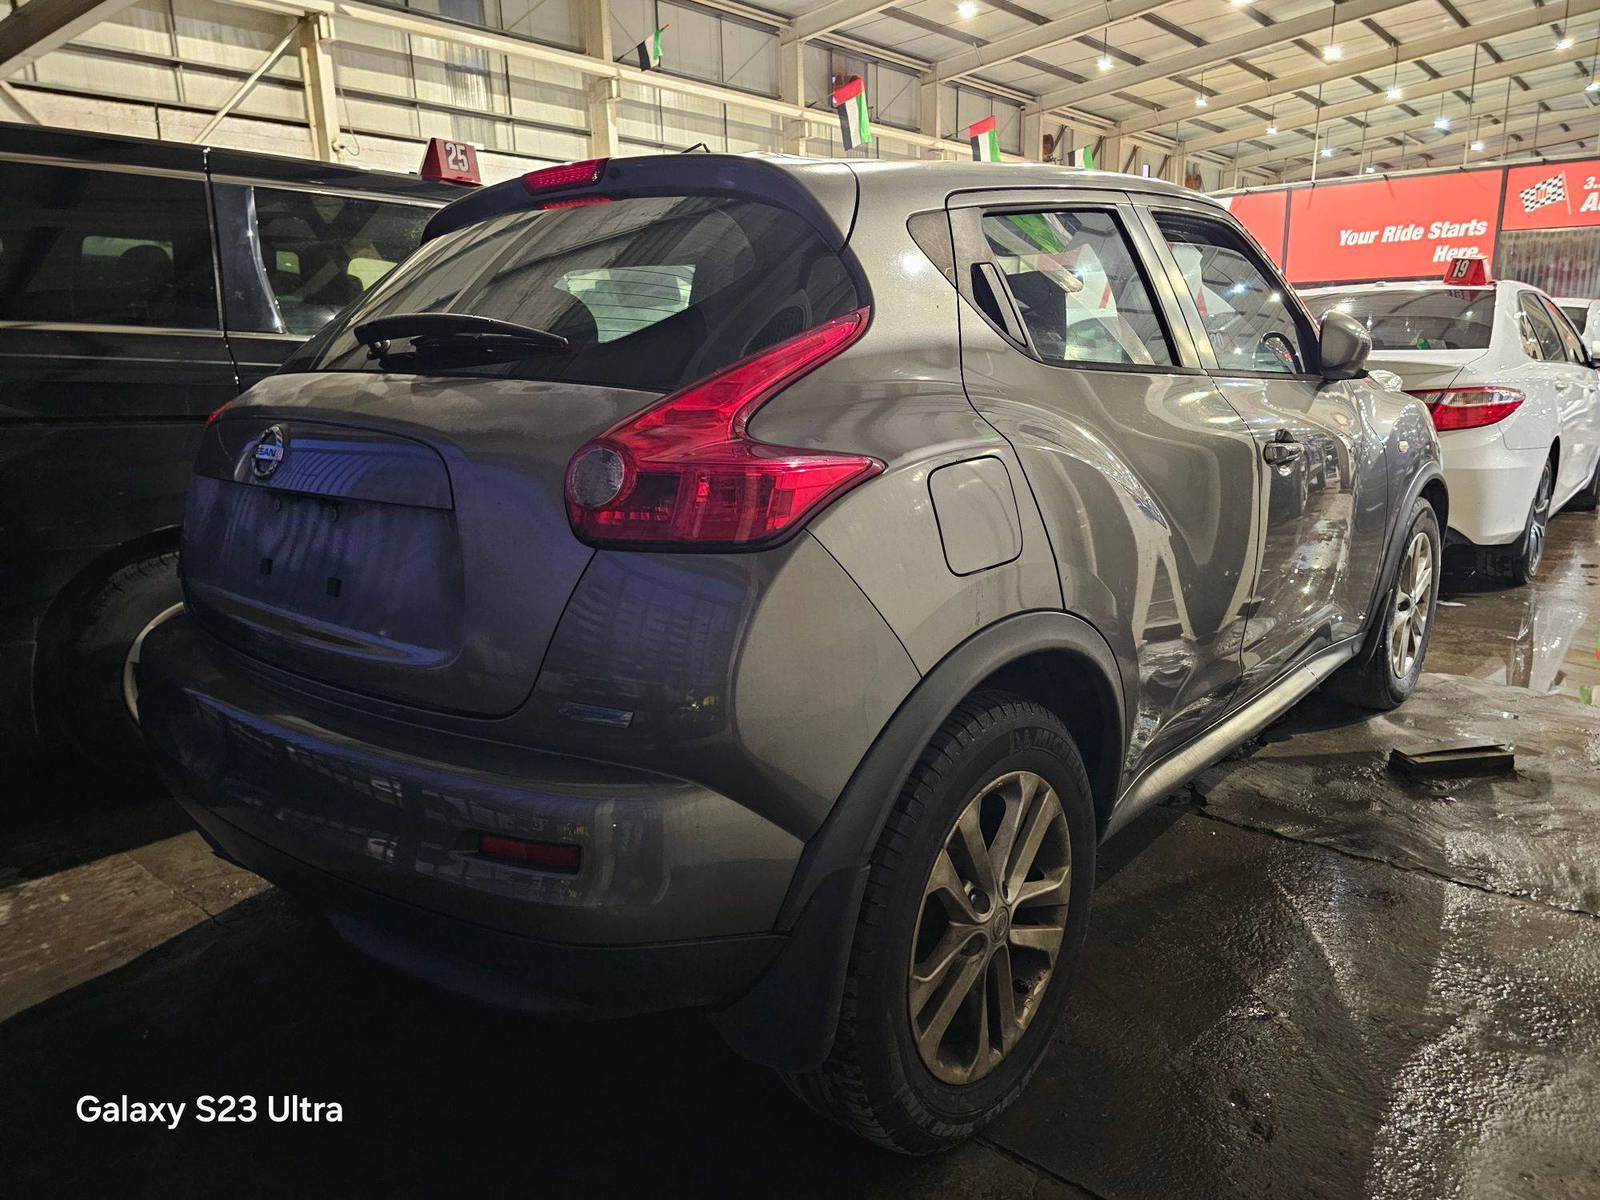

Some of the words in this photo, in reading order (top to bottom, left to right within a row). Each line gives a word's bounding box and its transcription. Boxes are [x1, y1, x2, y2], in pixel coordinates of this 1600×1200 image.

[445, 142, 469, 172] 25
[1339, 229, 1379, 246] Your
[1381, 224, 1425, 243] Ride
[1427, 218, 1488, 239] Starts
[1452, 259, 1469, 278] 19
